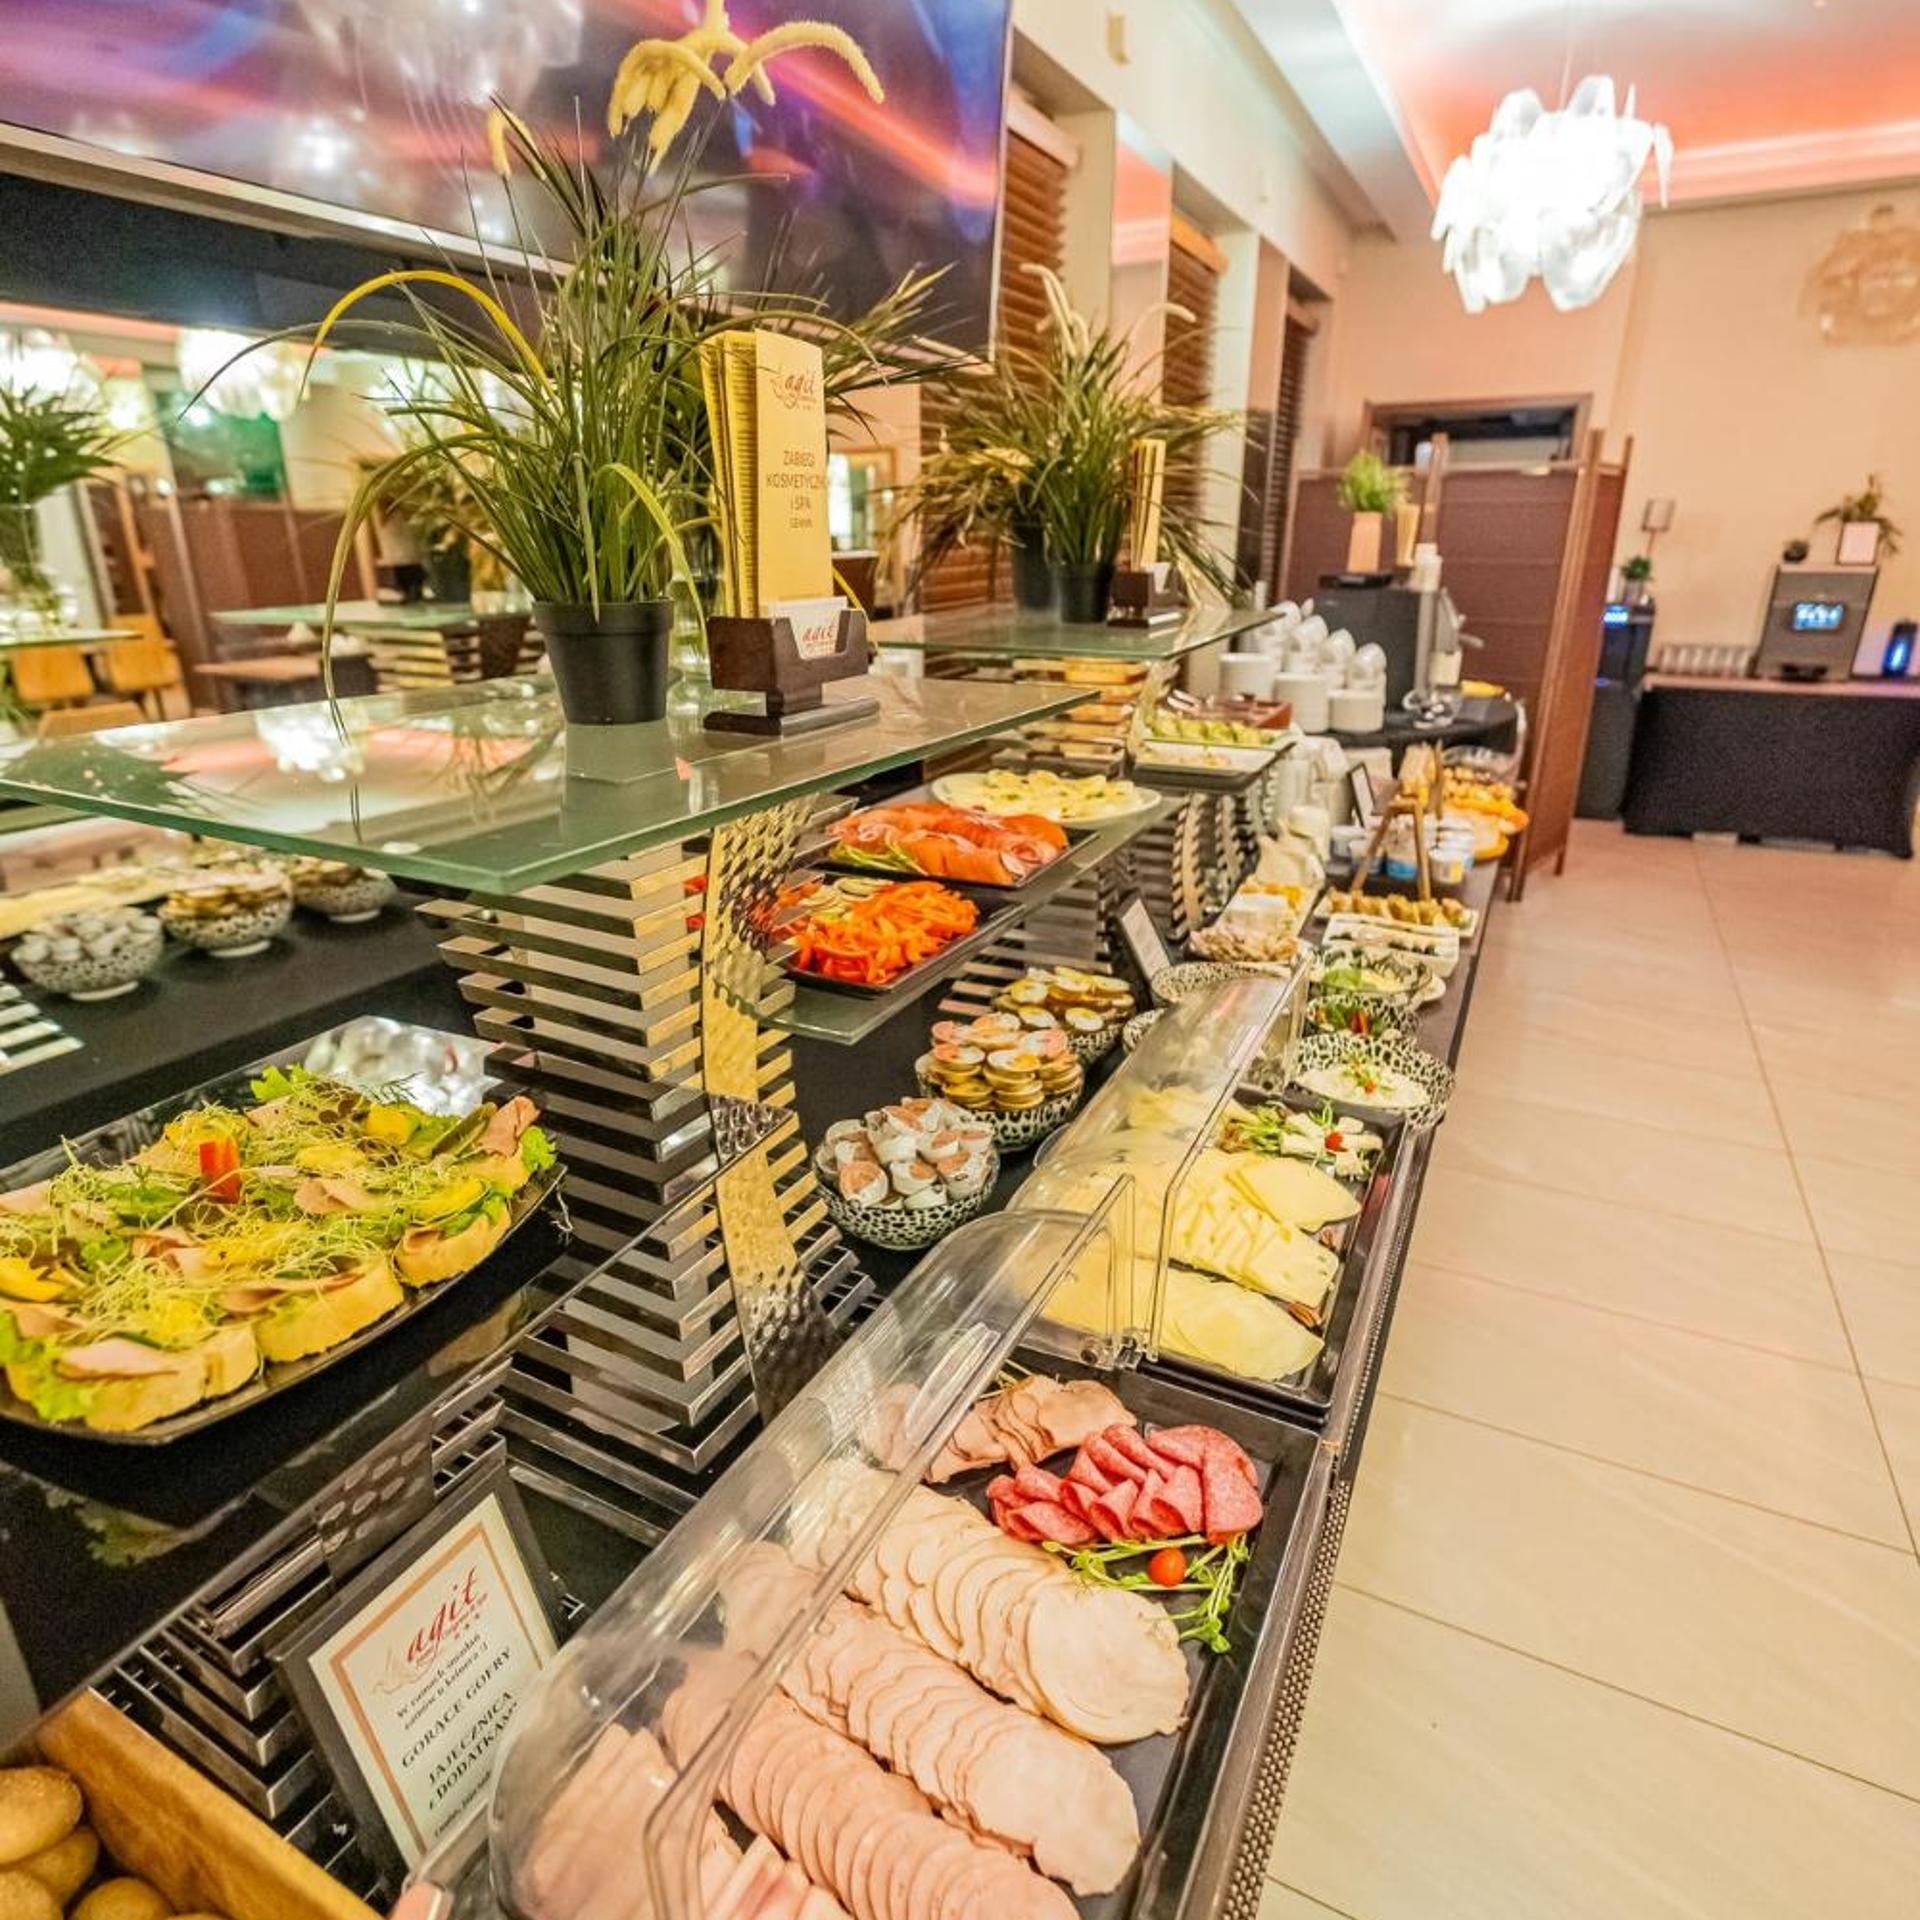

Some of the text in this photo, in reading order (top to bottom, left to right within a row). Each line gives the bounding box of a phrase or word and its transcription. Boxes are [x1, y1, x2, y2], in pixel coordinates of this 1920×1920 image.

[783, 449, 816, 467] ZABIEGI
[407, 1566, 478, 1664] agit
[402, 1698, 463, 1769] GORĄCE
[465, 1646, 512, 1700] GOFRY
[428, 1690, 514, 1786] JAJECZNICA
